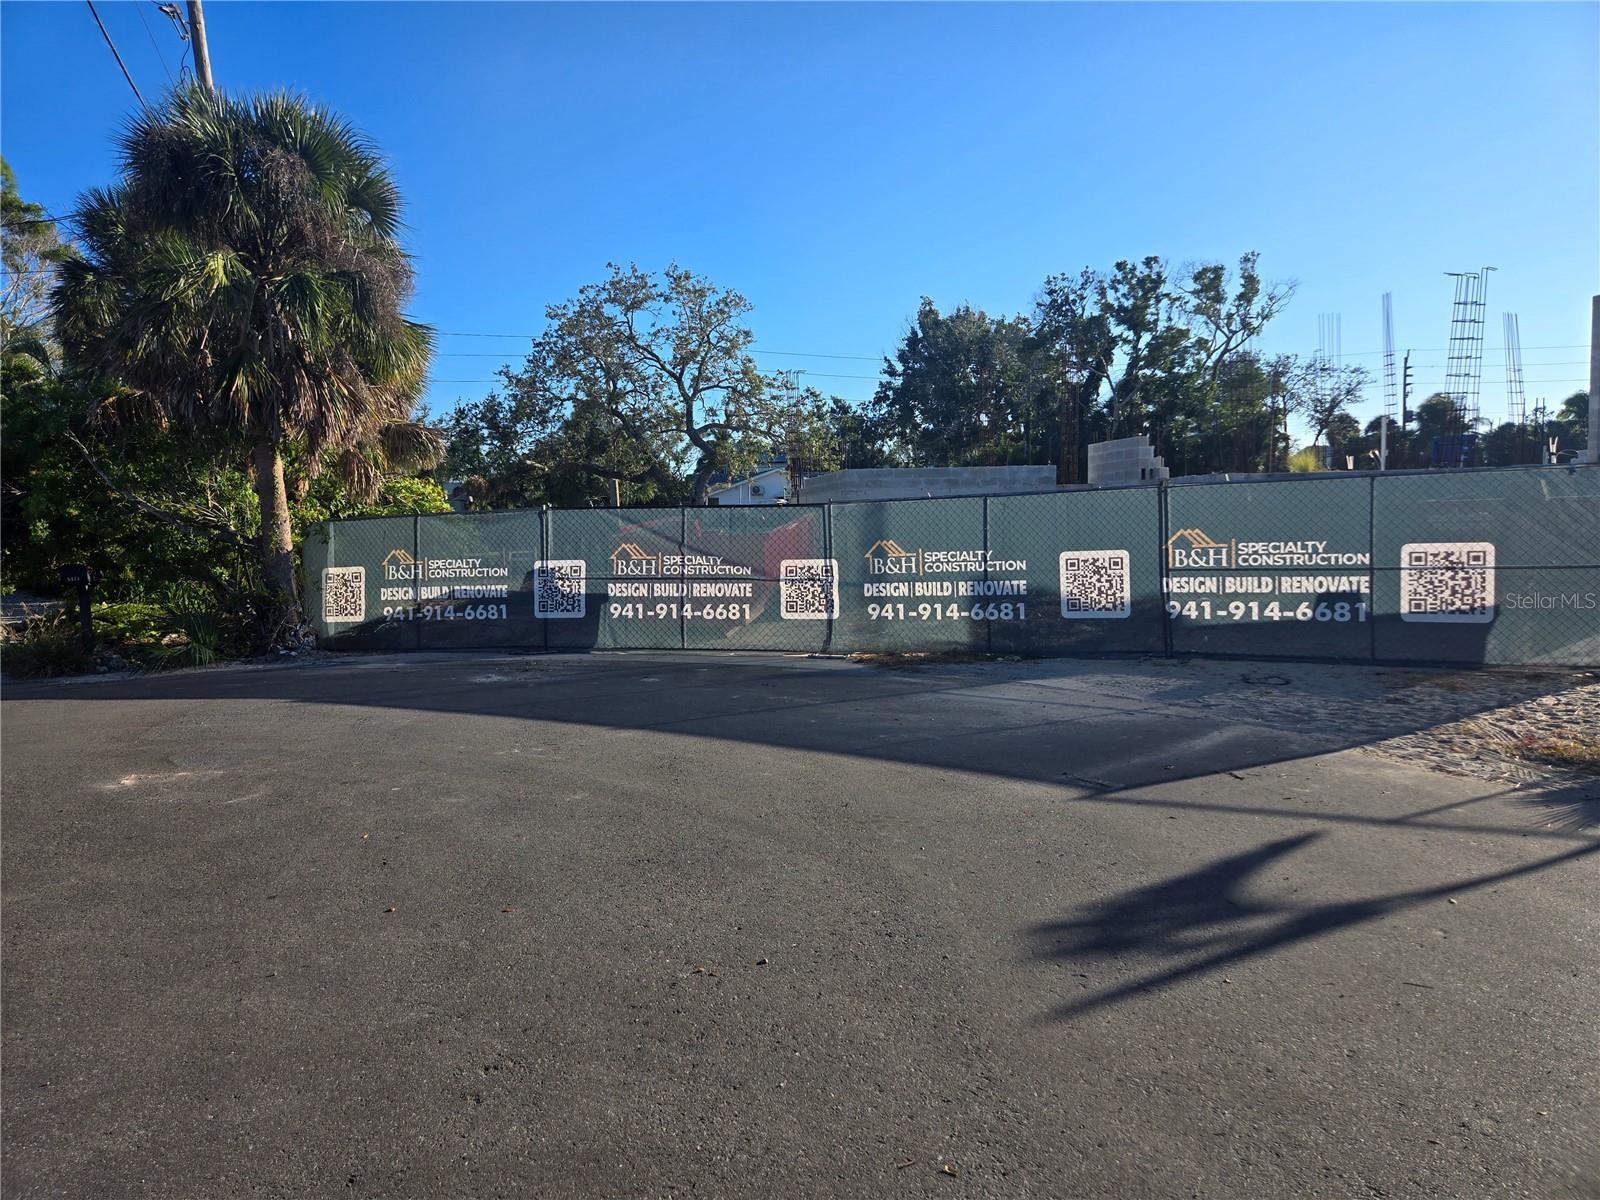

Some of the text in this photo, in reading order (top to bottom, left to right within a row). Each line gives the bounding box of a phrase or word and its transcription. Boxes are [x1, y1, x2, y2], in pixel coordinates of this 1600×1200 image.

[1238, 541, 1327, 554] SPECIALTY
[428, 558, 482, 569] SPECIALTY
[663, 555, 724, 565] SPECIALTY
[924, 550, 993, 562] SPECIALTY
[1174, 548, 1228, 567] B&H
[1238, 552, 1370, 566] CONSTRUCTION
[388, 564, 423, 580] B&H
[428, 568, 508, 578] CONSTRUCTION
[617, 559, 656, 575] B&H
[663, 565, 752, 575] CONSTRUCTION
[874, 556, 917, 575] B&H
[924, 560, 1027, 573] CONSTRUCTION
[383, 604, 507, 621] 941-914-6681
[609, 603, 750, 620] 941-914-6681
[867, 602, 1026, 620] 941-914-6681
[1165, 601, 1366, 622] 941-914-6681
